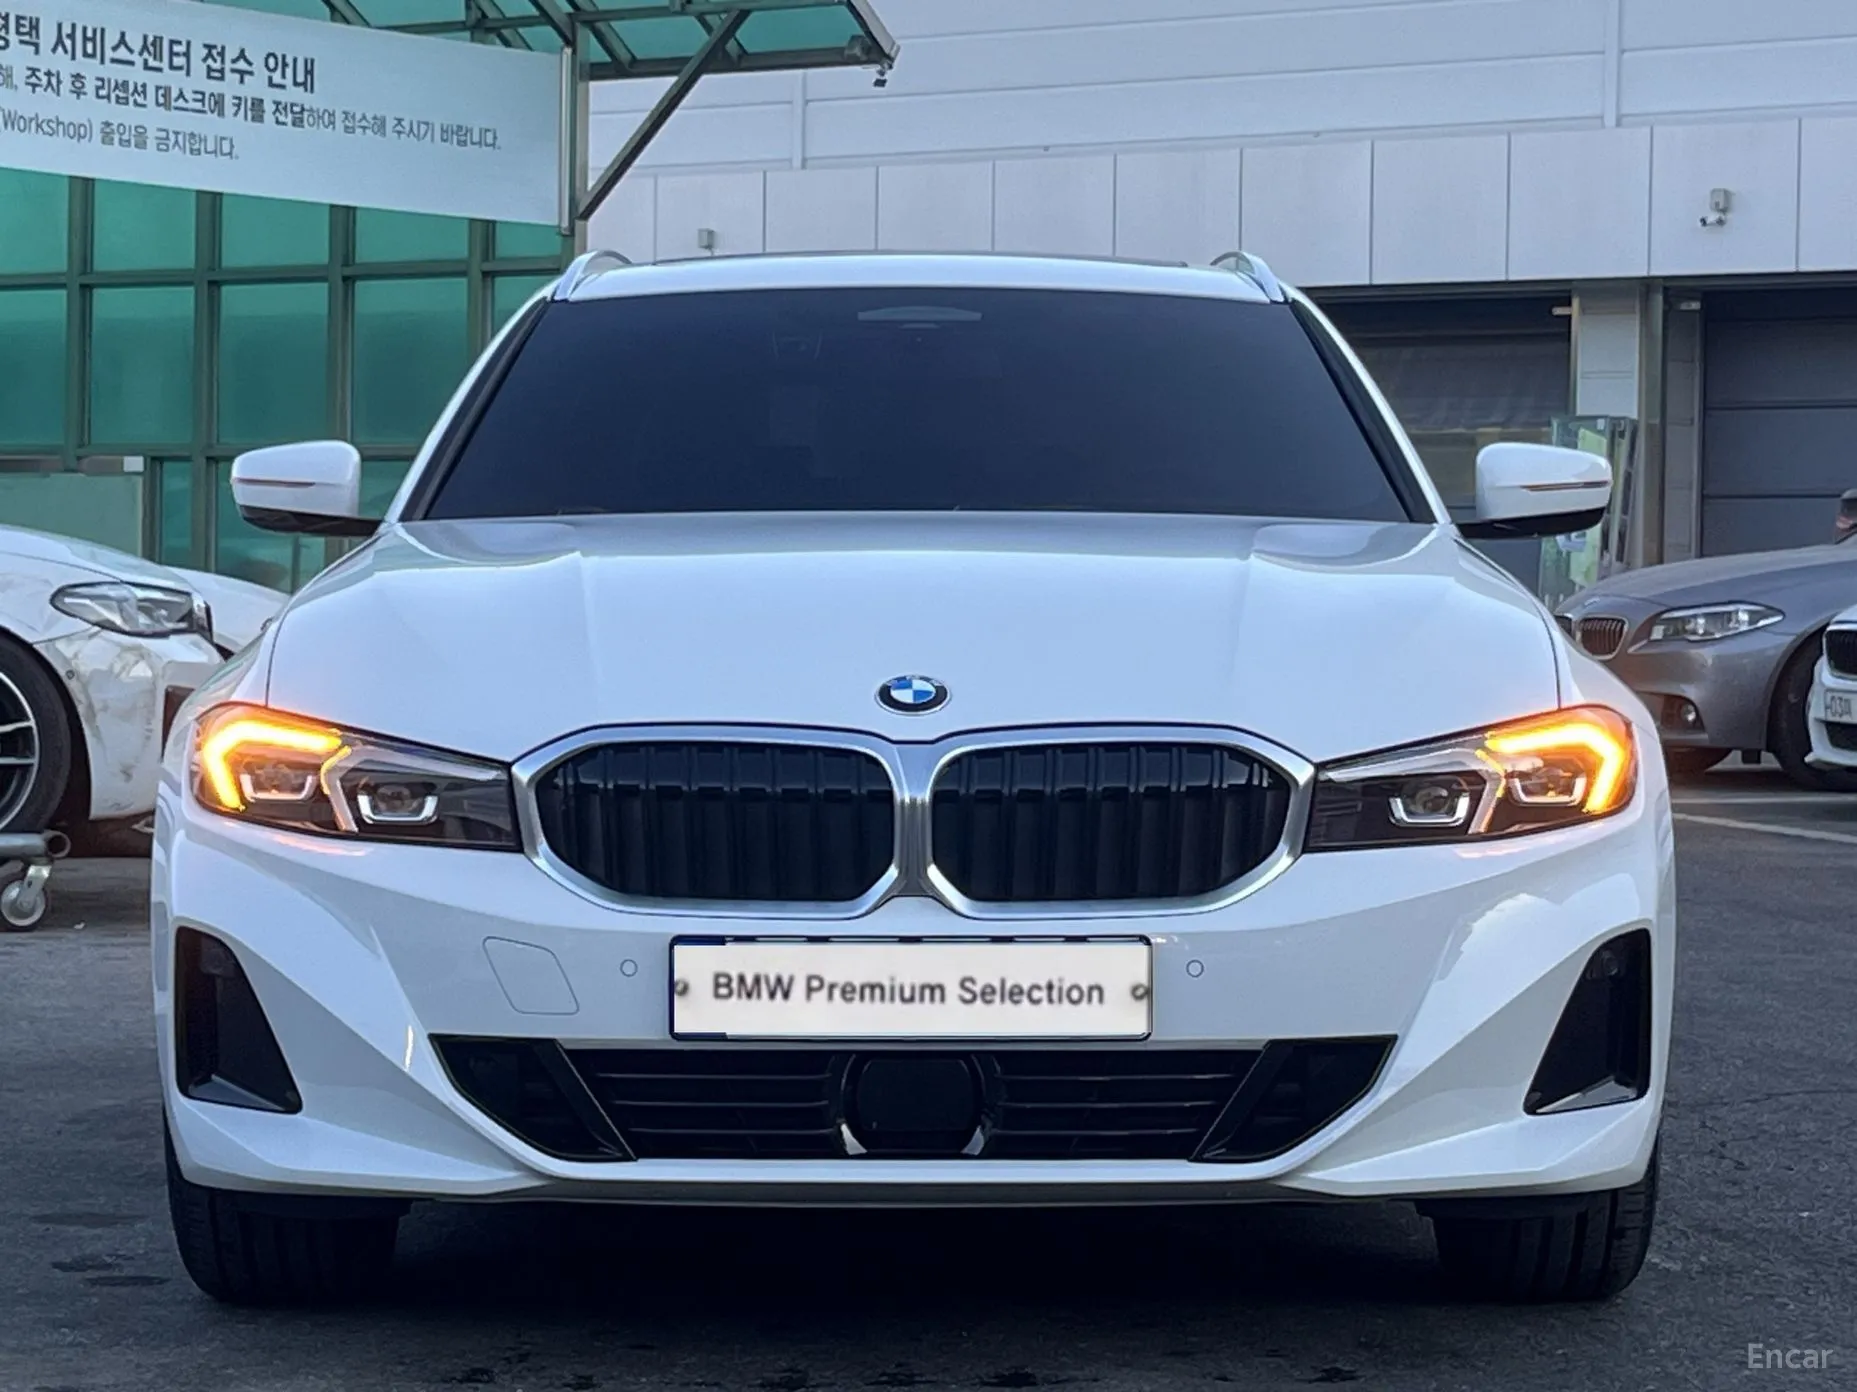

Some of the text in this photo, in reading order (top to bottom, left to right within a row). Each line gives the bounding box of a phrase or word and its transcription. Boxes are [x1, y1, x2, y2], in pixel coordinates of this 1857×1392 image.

[51, 21, 192, 77] 서비스센터
[202, 42, 255, 84] 접수
[264, 51, 315, 94] 안내
[24, 66, 62, 97] 주차
[69, 72, 88, 100] 후
[94, 76, 148, 109] 리셉션
[155, 85, 225, 118] 데스크에
[231, 95, 266, 124] 키를
[271, 100, 336, 131] 전달하여
[341, 110, 387, 138] 접수해
[391, 116, 435, 143] 주시기
[440, 123, 501, 150] 바랍니다.
[100, 120, 148, 150] 출입을
[155, 127, 239, 160] 금지합니다.
[712, 971, 1105, 1006] BMW Premium Selection
